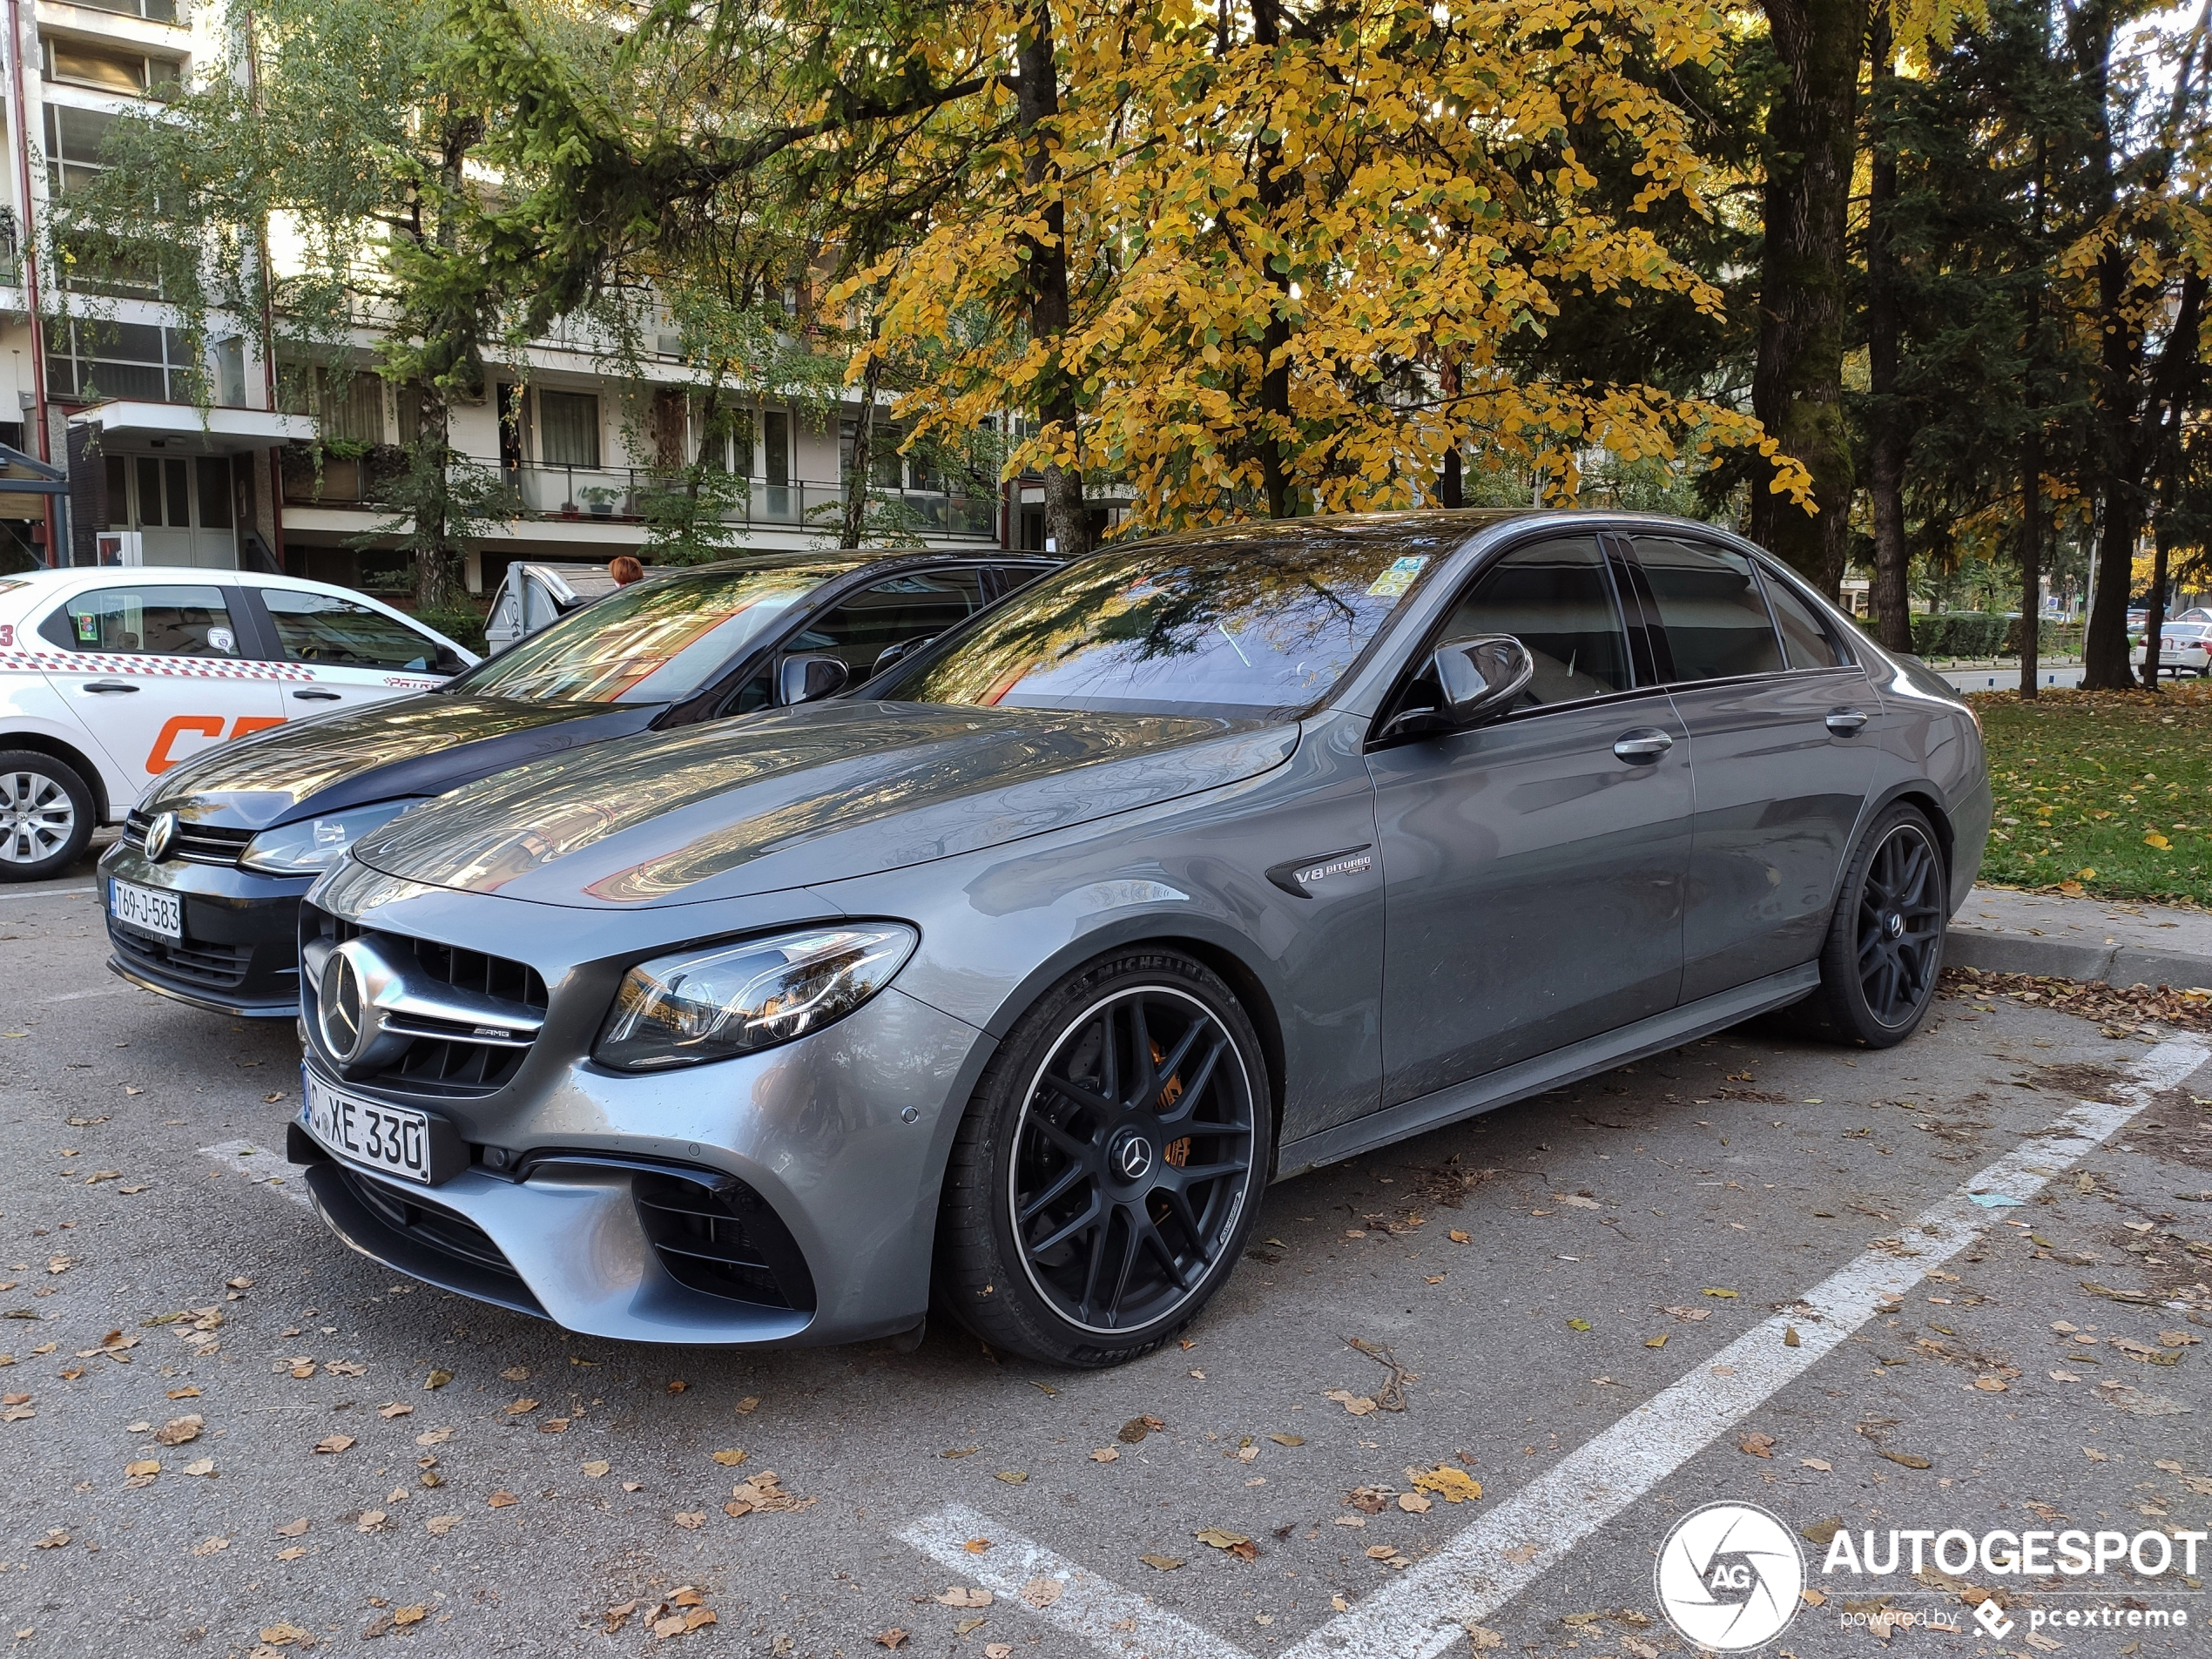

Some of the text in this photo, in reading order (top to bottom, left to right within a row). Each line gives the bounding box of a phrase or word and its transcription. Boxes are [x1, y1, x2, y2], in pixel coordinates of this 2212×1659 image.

[1295, 856, 1371, 884] V8 BITURBO
[117, 886, 178, 930] T69-J-583
[1097, 956, 1199, 981] MICHELIN
[328, 1096, 359, 1152] XE
[365, 1109, 422, 1170] 330
